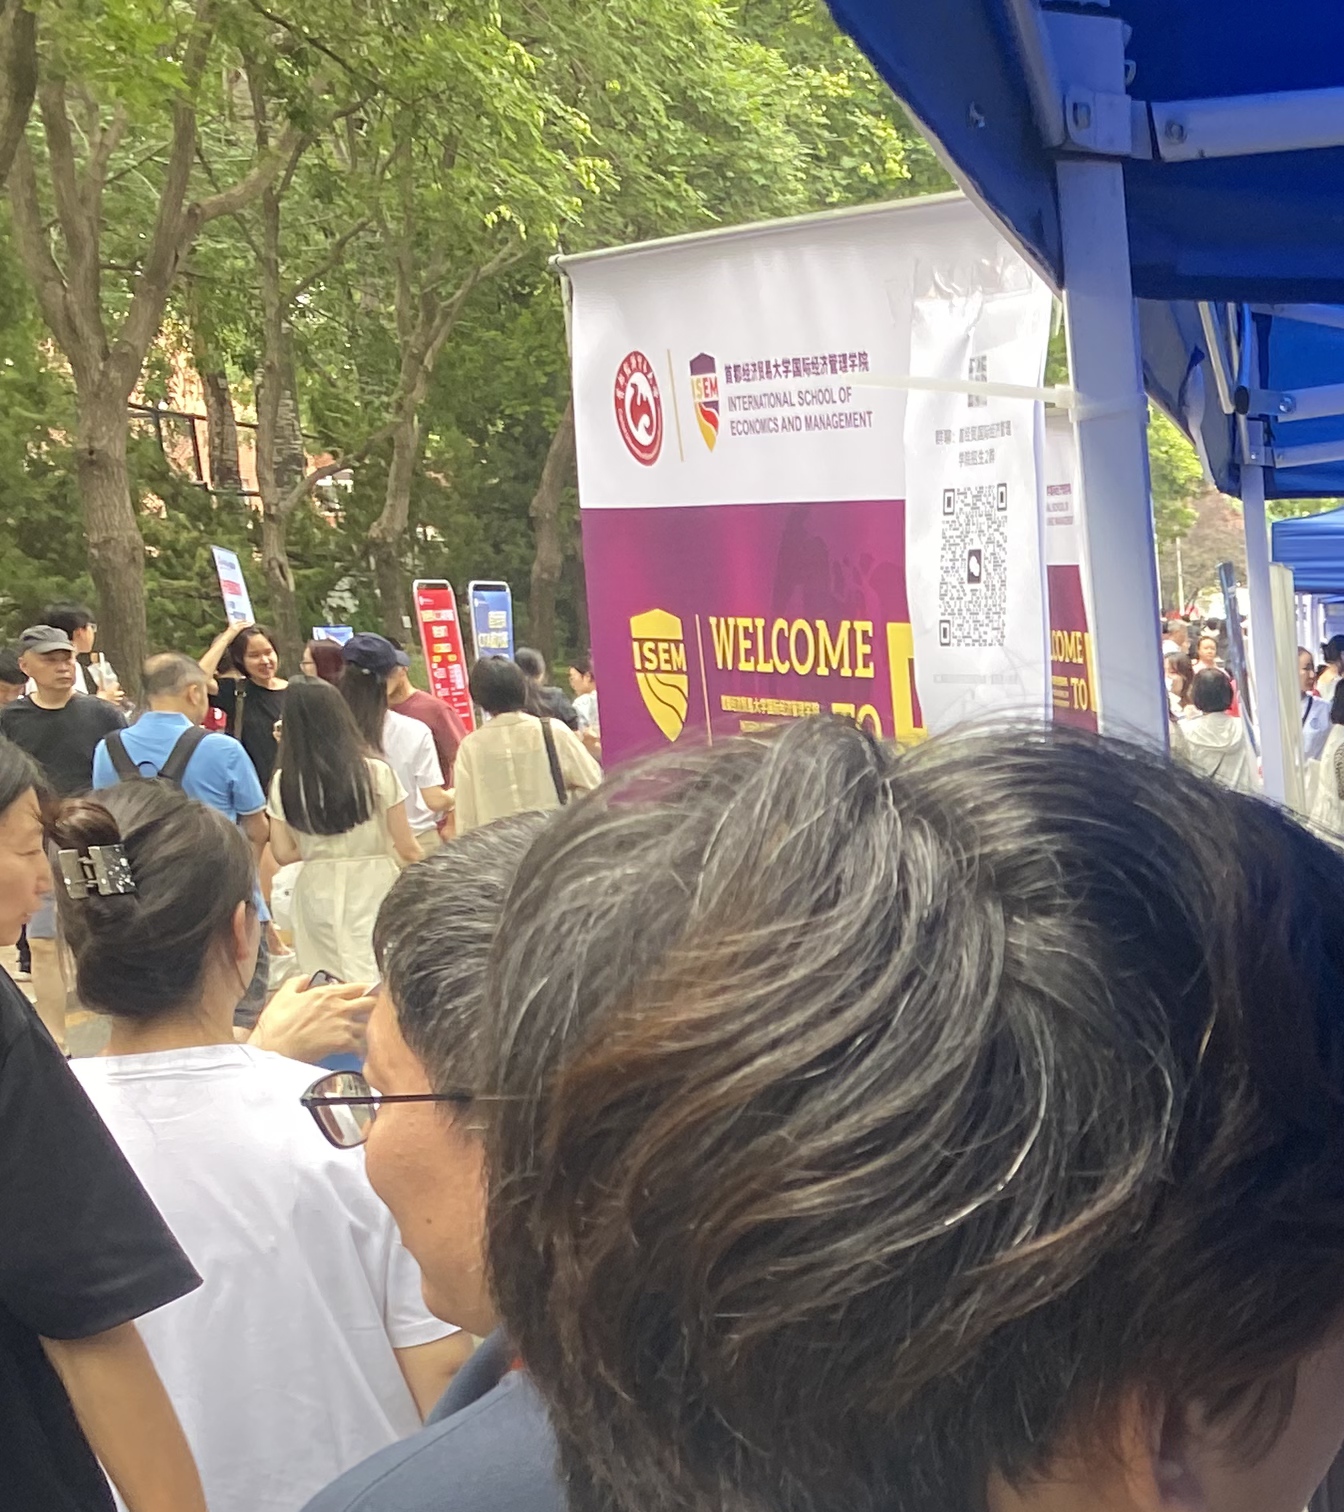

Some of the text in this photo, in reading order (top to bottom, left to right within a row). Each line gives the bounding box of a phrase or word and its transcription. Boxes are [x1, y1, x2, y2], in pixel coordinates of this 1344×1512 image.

[690, 376, 719, 401] ISEM
[728, 386, 853, 412] INTERNATIONAL SCHOOL OF
[730, 410, 874, 436] ECONOMICS AND MANAGEMENT
[632, 640, 687, 672] ISEM
[708, 616, 875, 678] WELCOME
[1049, 629, 1084, 664] COME
[1070, 676, 1088, 711] TO
